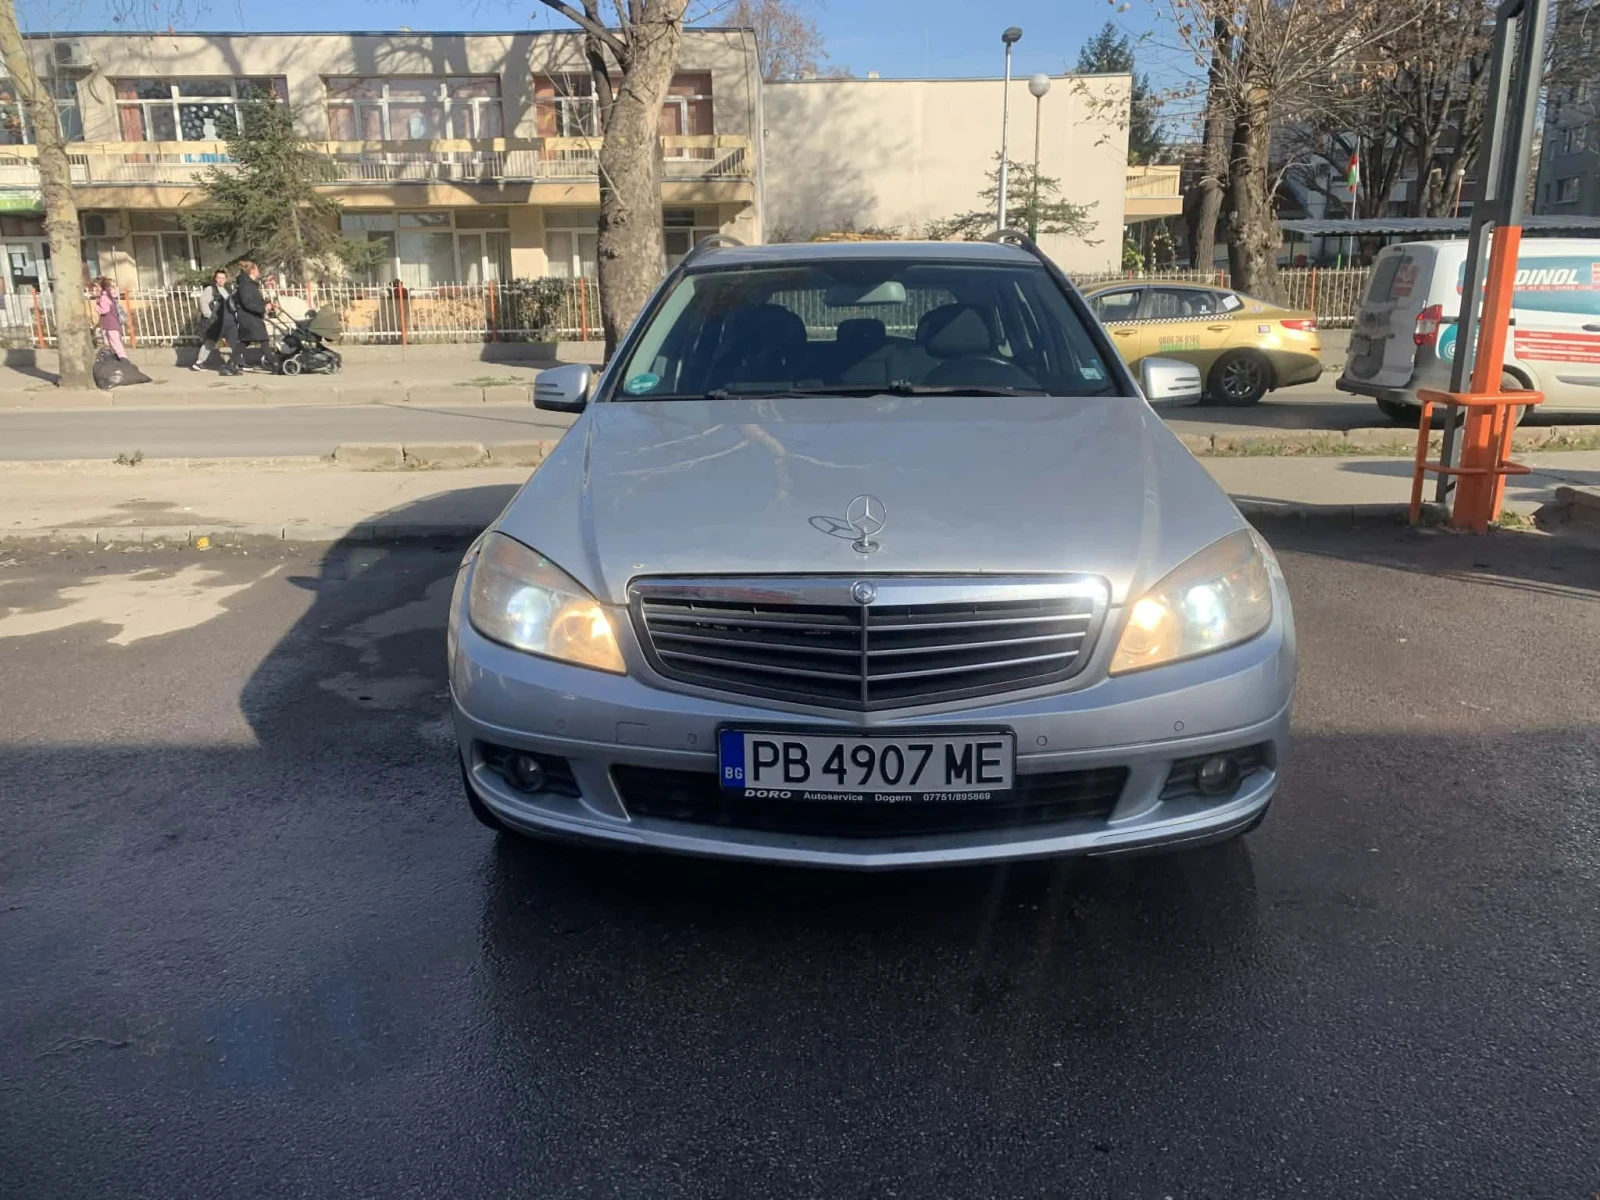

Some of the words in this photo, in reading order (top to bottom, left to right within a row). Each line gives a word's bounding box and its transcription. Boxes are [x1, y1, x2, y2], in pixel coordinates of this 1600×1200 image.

[1514, 268, 1579, 285] DINOL
[752, 740, 811, 783] PB
[822, 743, 934, 786] 4907
[944, 742, 1004, 785] ME
[724, 766, 744, 780] BG
[744, 789, 792, 799] DORO
[803, 791, 864, 801] Autoservice
[874, 793, 912, 803] Dogern
